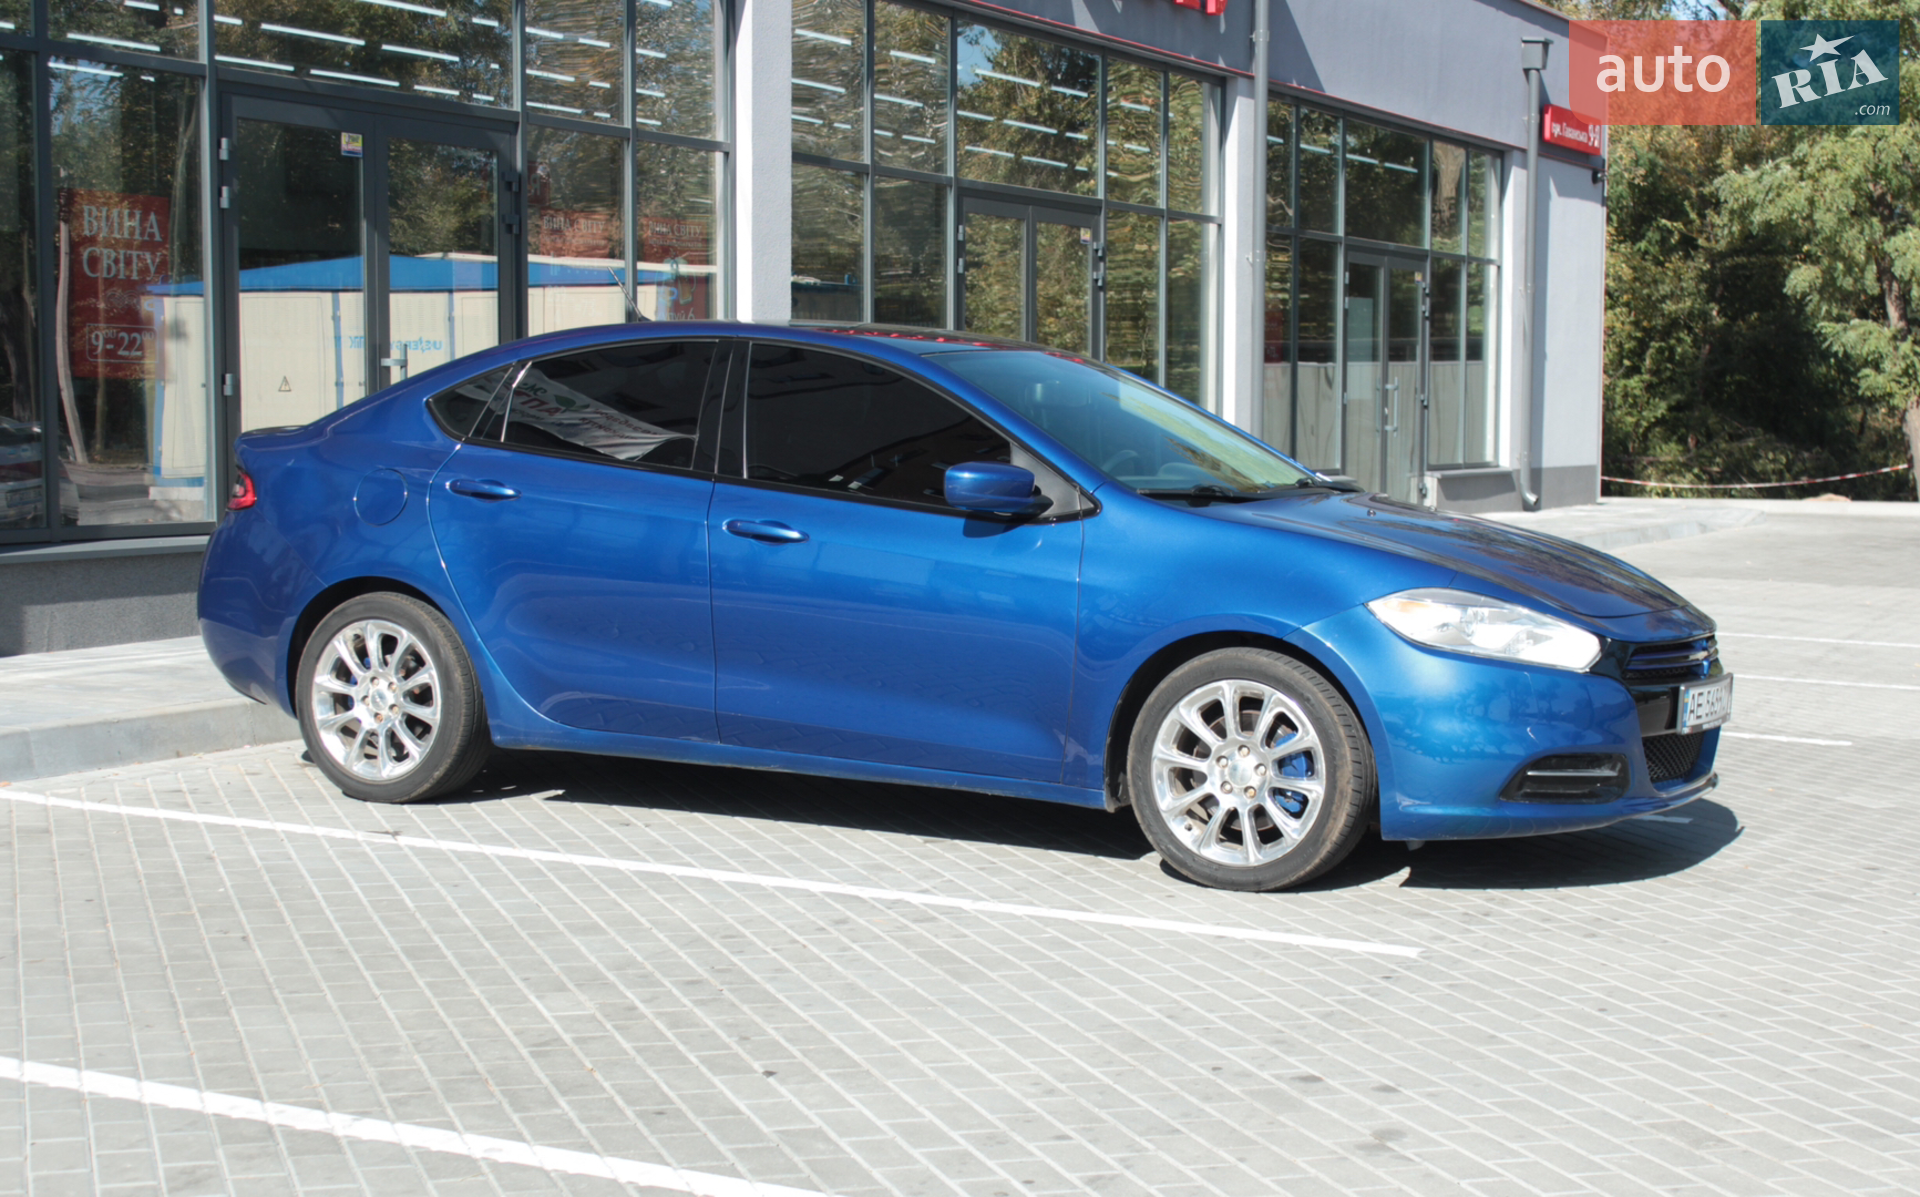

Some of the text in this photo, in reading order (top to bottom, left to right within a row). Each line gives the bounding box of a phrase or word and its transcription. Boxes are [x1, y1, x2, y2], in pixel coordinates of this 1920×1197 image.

[82, 205, 163, 242] ВИНА
[674, 223, 702, 237] СВІТУ
[82, 247, 163, 280] СВІТУ
